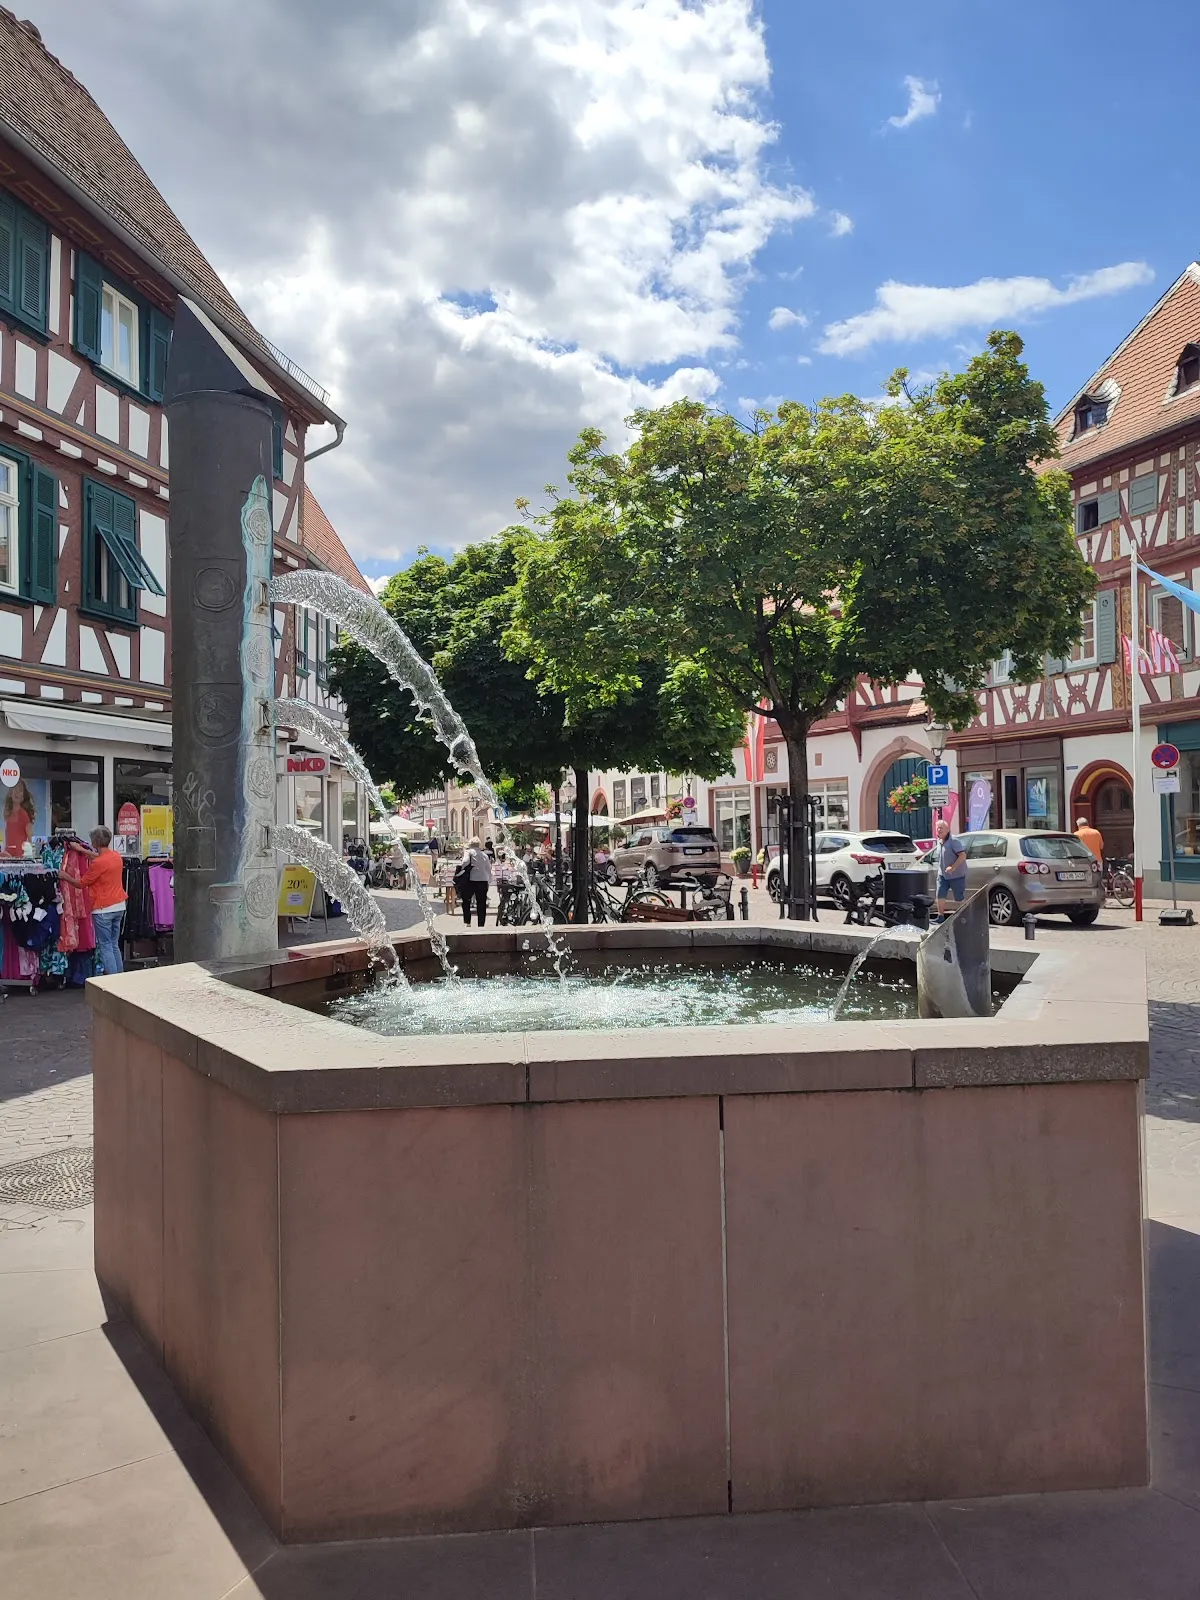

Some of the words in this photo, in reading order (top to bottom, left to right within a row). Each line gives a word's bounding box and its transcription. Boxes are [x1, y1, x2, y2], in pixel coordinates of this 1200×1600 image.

[287, 757, 326, 772] NKD
[2, 768, 18, 777] NKD
[932, 768, 944, 784] P
